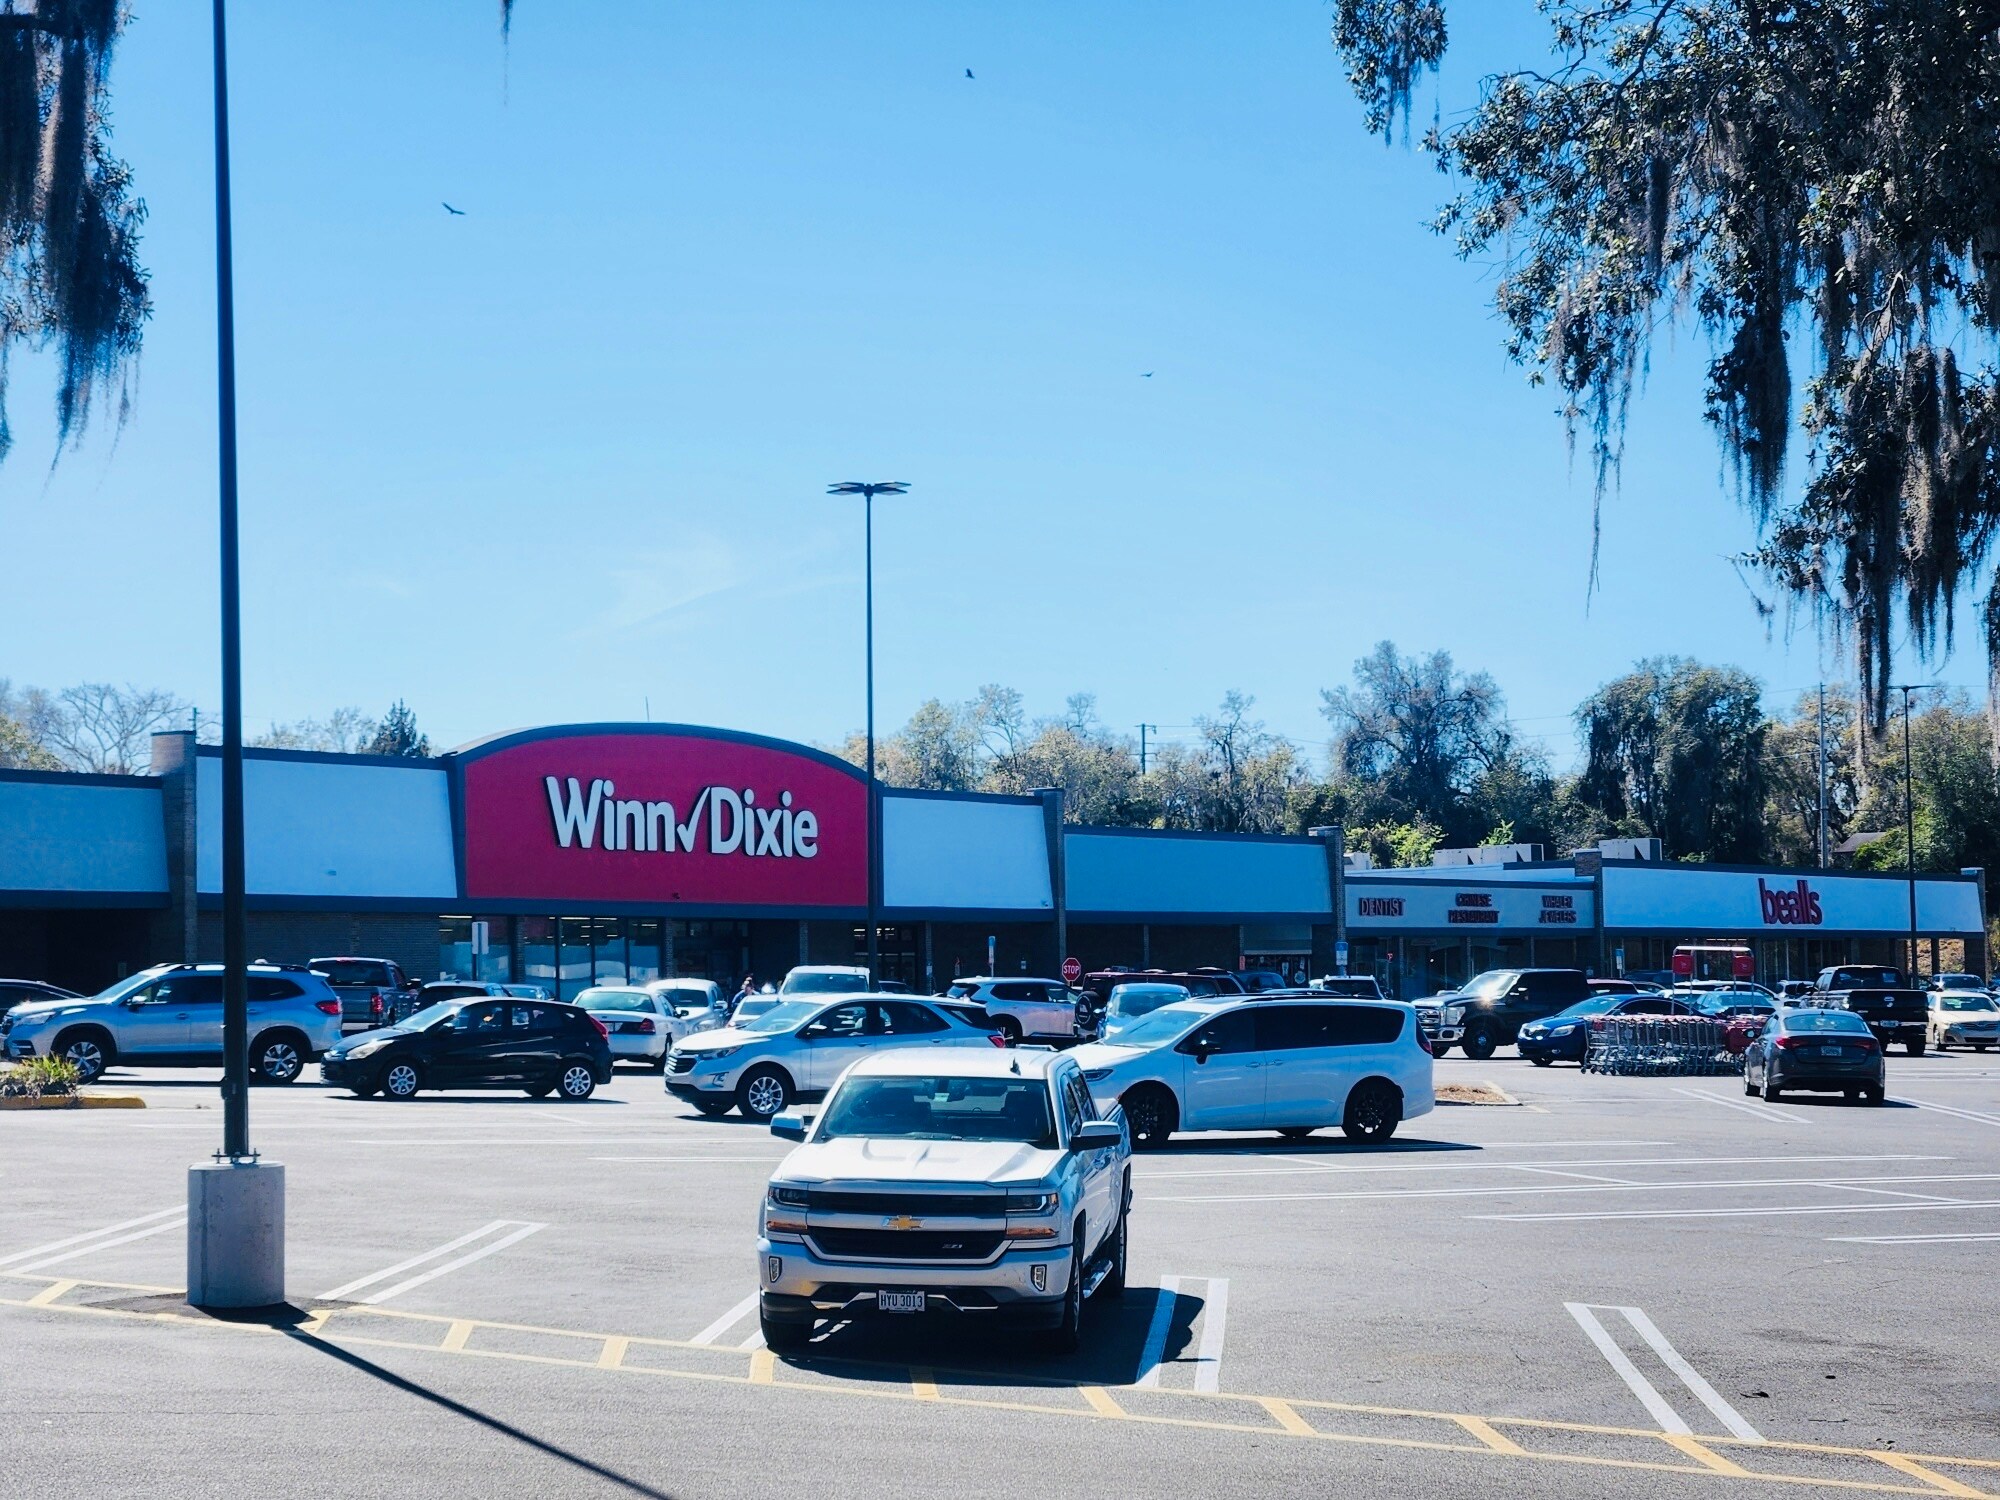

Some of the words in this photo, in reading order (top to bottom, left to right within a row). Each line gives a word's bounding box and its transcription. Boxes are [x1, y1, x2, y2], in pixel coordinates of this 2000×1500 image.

[545, 775, 676, 853] Winn
[710, 786, 819, 858] Dixie
[1359, 898, 1406, 917] DENTIST
[1758, 877, 1823, 925] bealls
[1063, 965, 1080, 974] STOP
[880, 1294, 898, 1307] HYU
[900, 1294, 923, 1308] 3013
